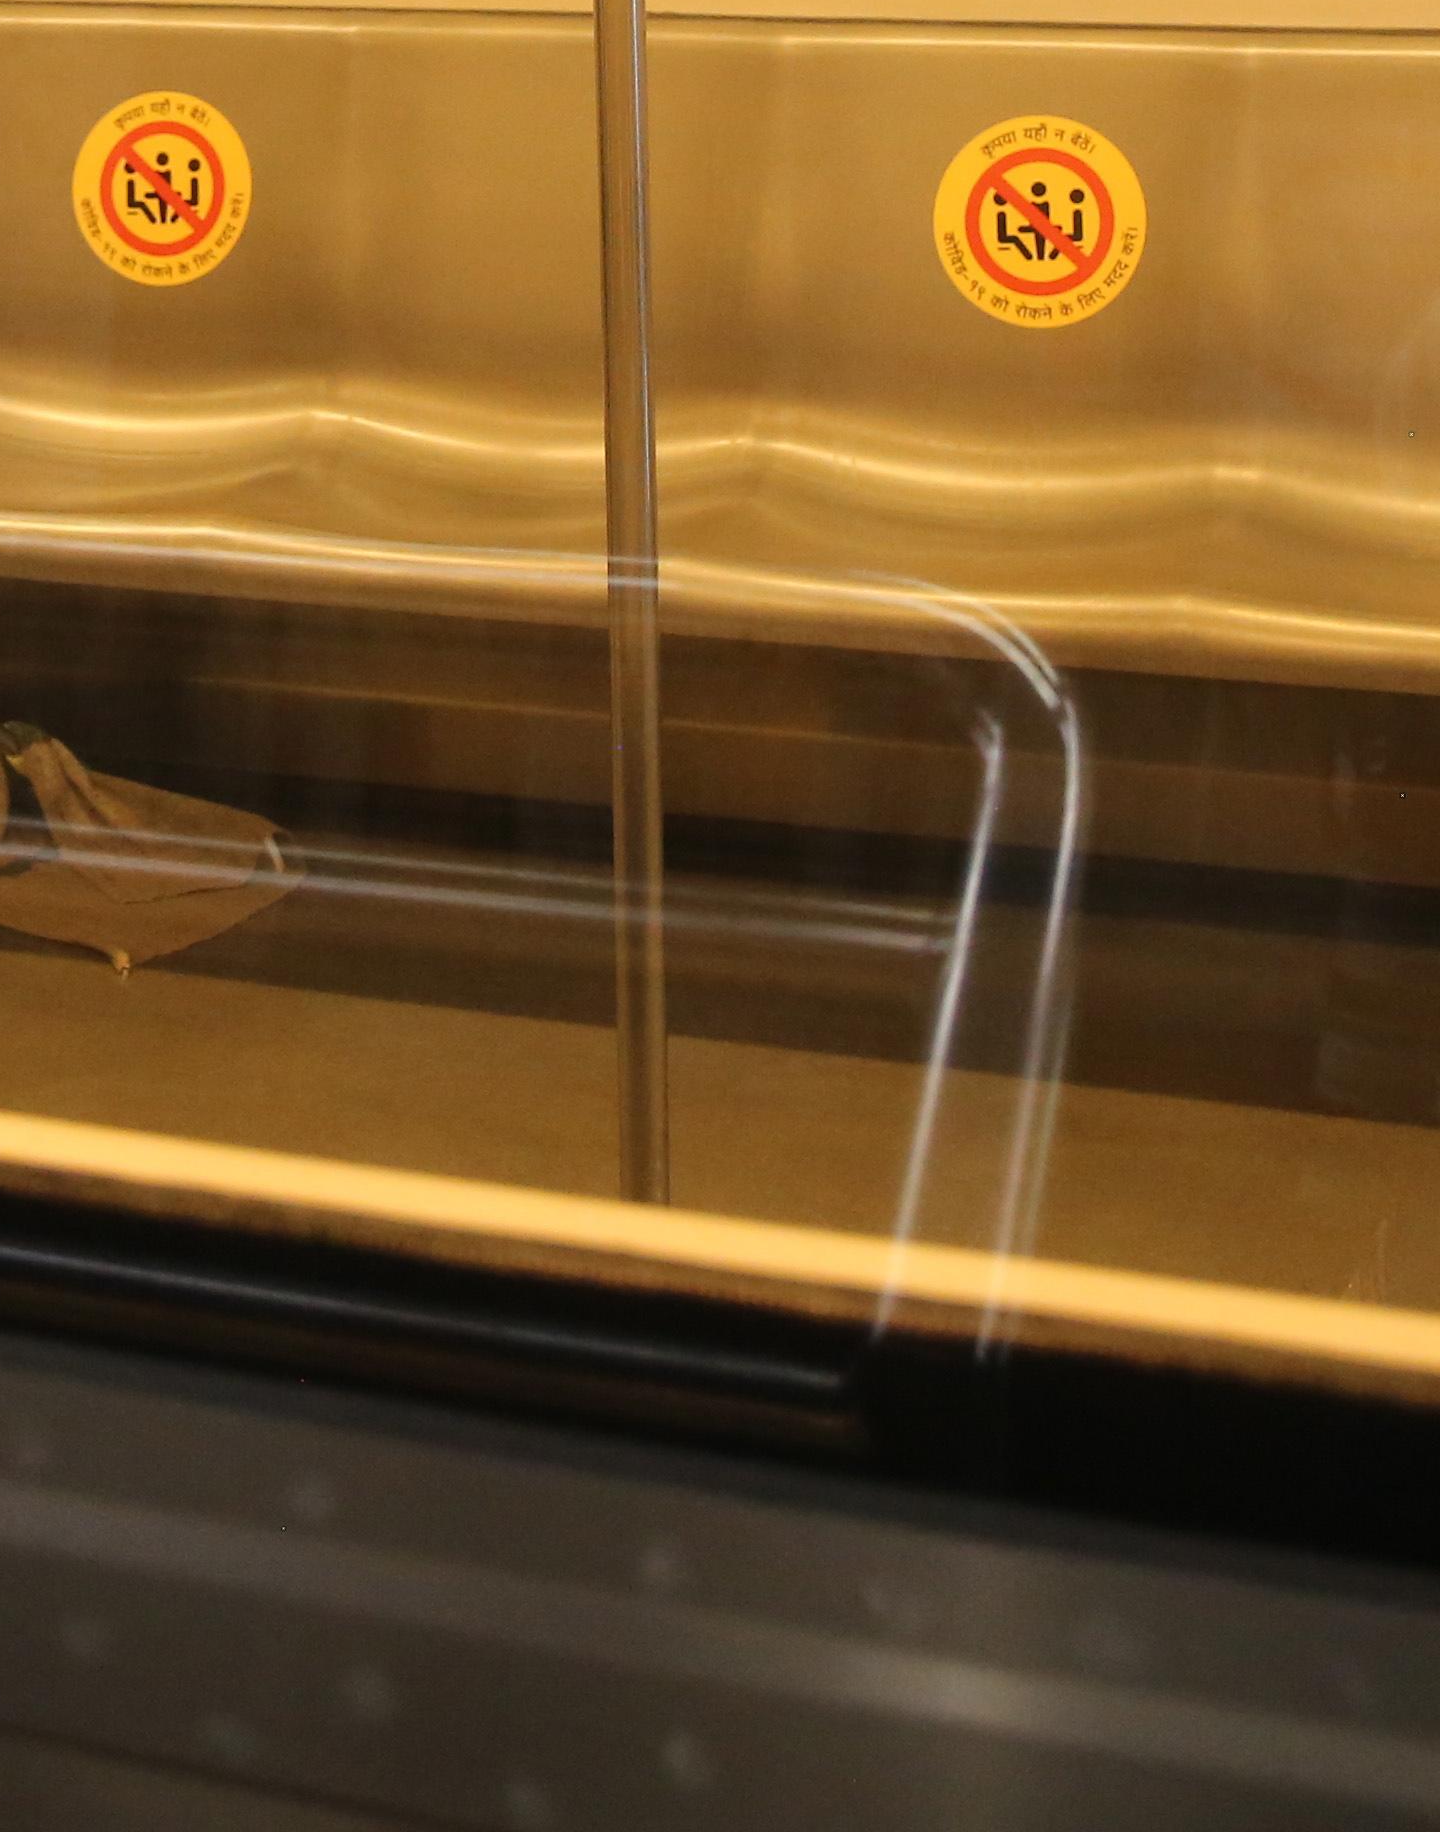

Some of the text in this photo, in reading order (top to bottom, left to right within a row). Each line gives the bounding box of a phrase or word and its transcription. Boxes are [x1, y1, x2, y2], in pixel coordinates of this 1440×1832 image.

[980, 130, 1017, 159] कृपया
[1054, 129, 1065, 141] न
[990, 295, 1010, 312] को
[1015, 302, 1052, 320] रोकने
[1059, 301, 1074, 316] के
[1076, 287, 1106, 310] लिए
[1102, 259, 1130, 288] मदद
